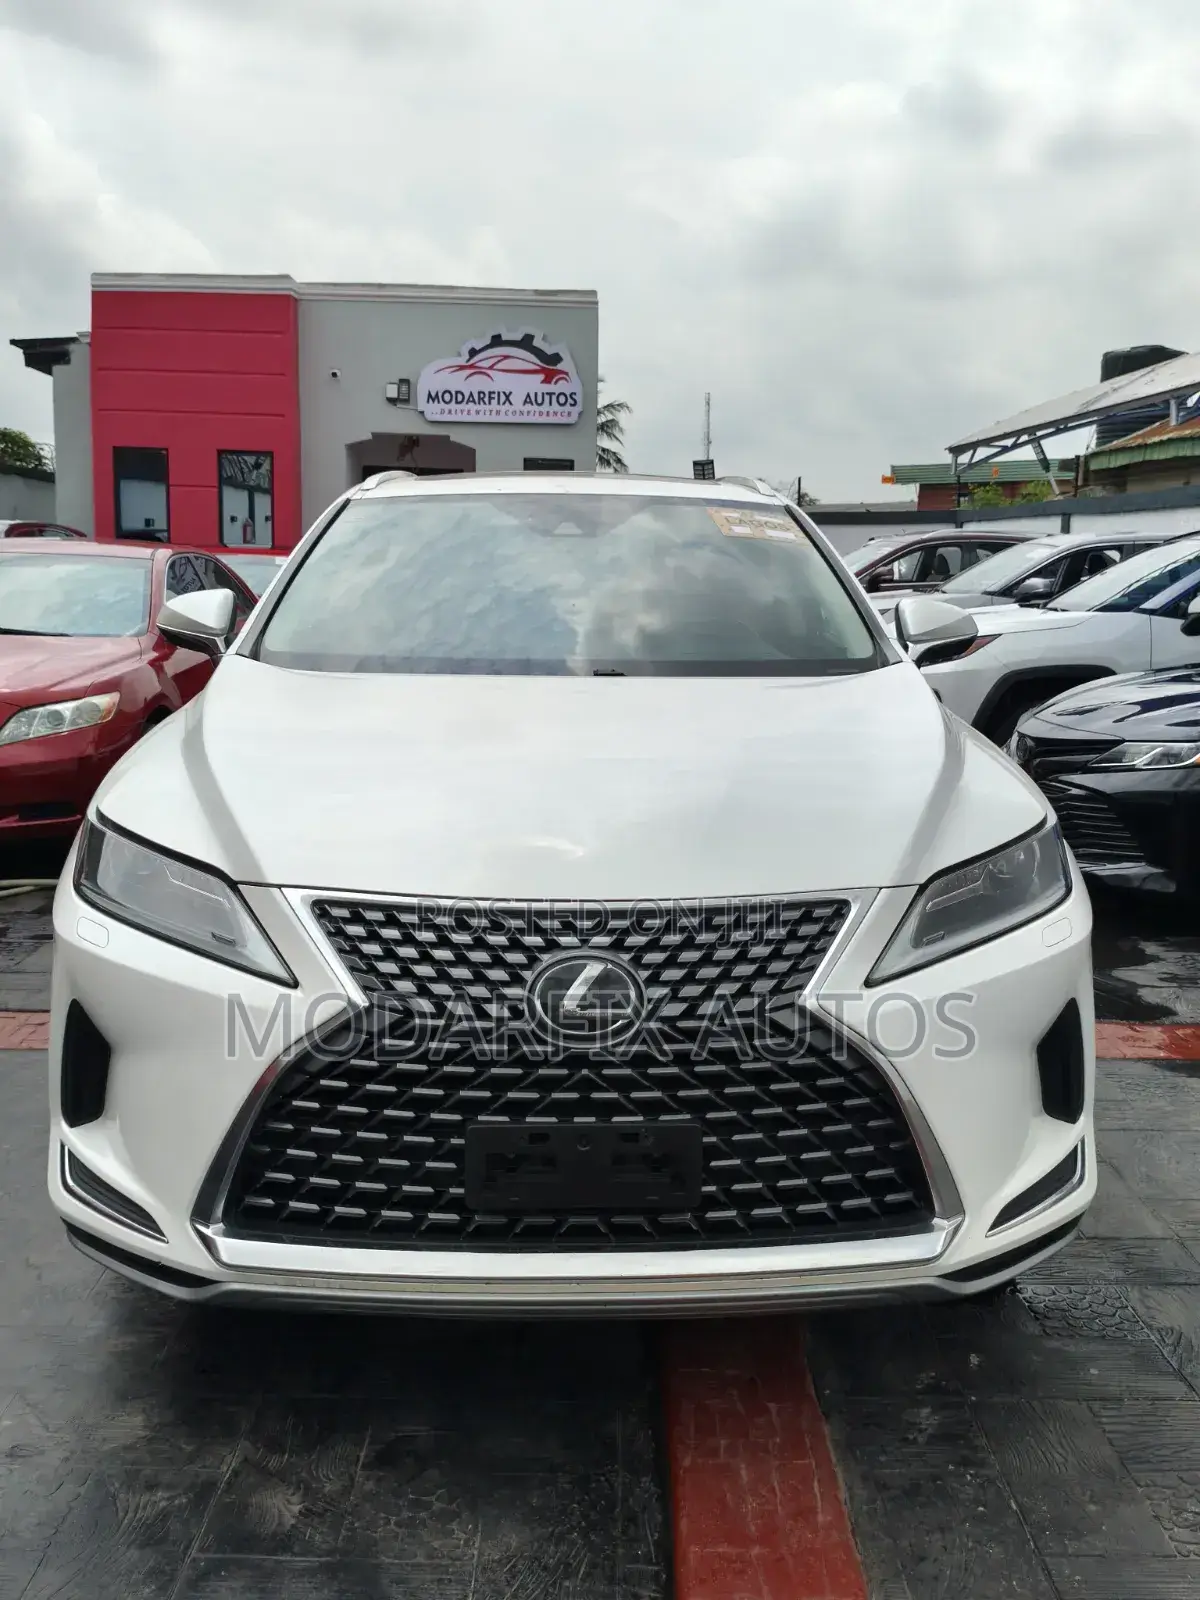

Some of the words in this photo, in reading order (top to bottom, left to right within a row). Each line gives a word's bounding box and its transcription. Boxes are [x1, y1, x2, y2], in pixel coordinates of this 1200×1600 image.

[426, 389, 513, 406] MODARFIX
[522, 391, 578, 407] AUTOS
[504, 409, 573, 418] CONFIDENCE
